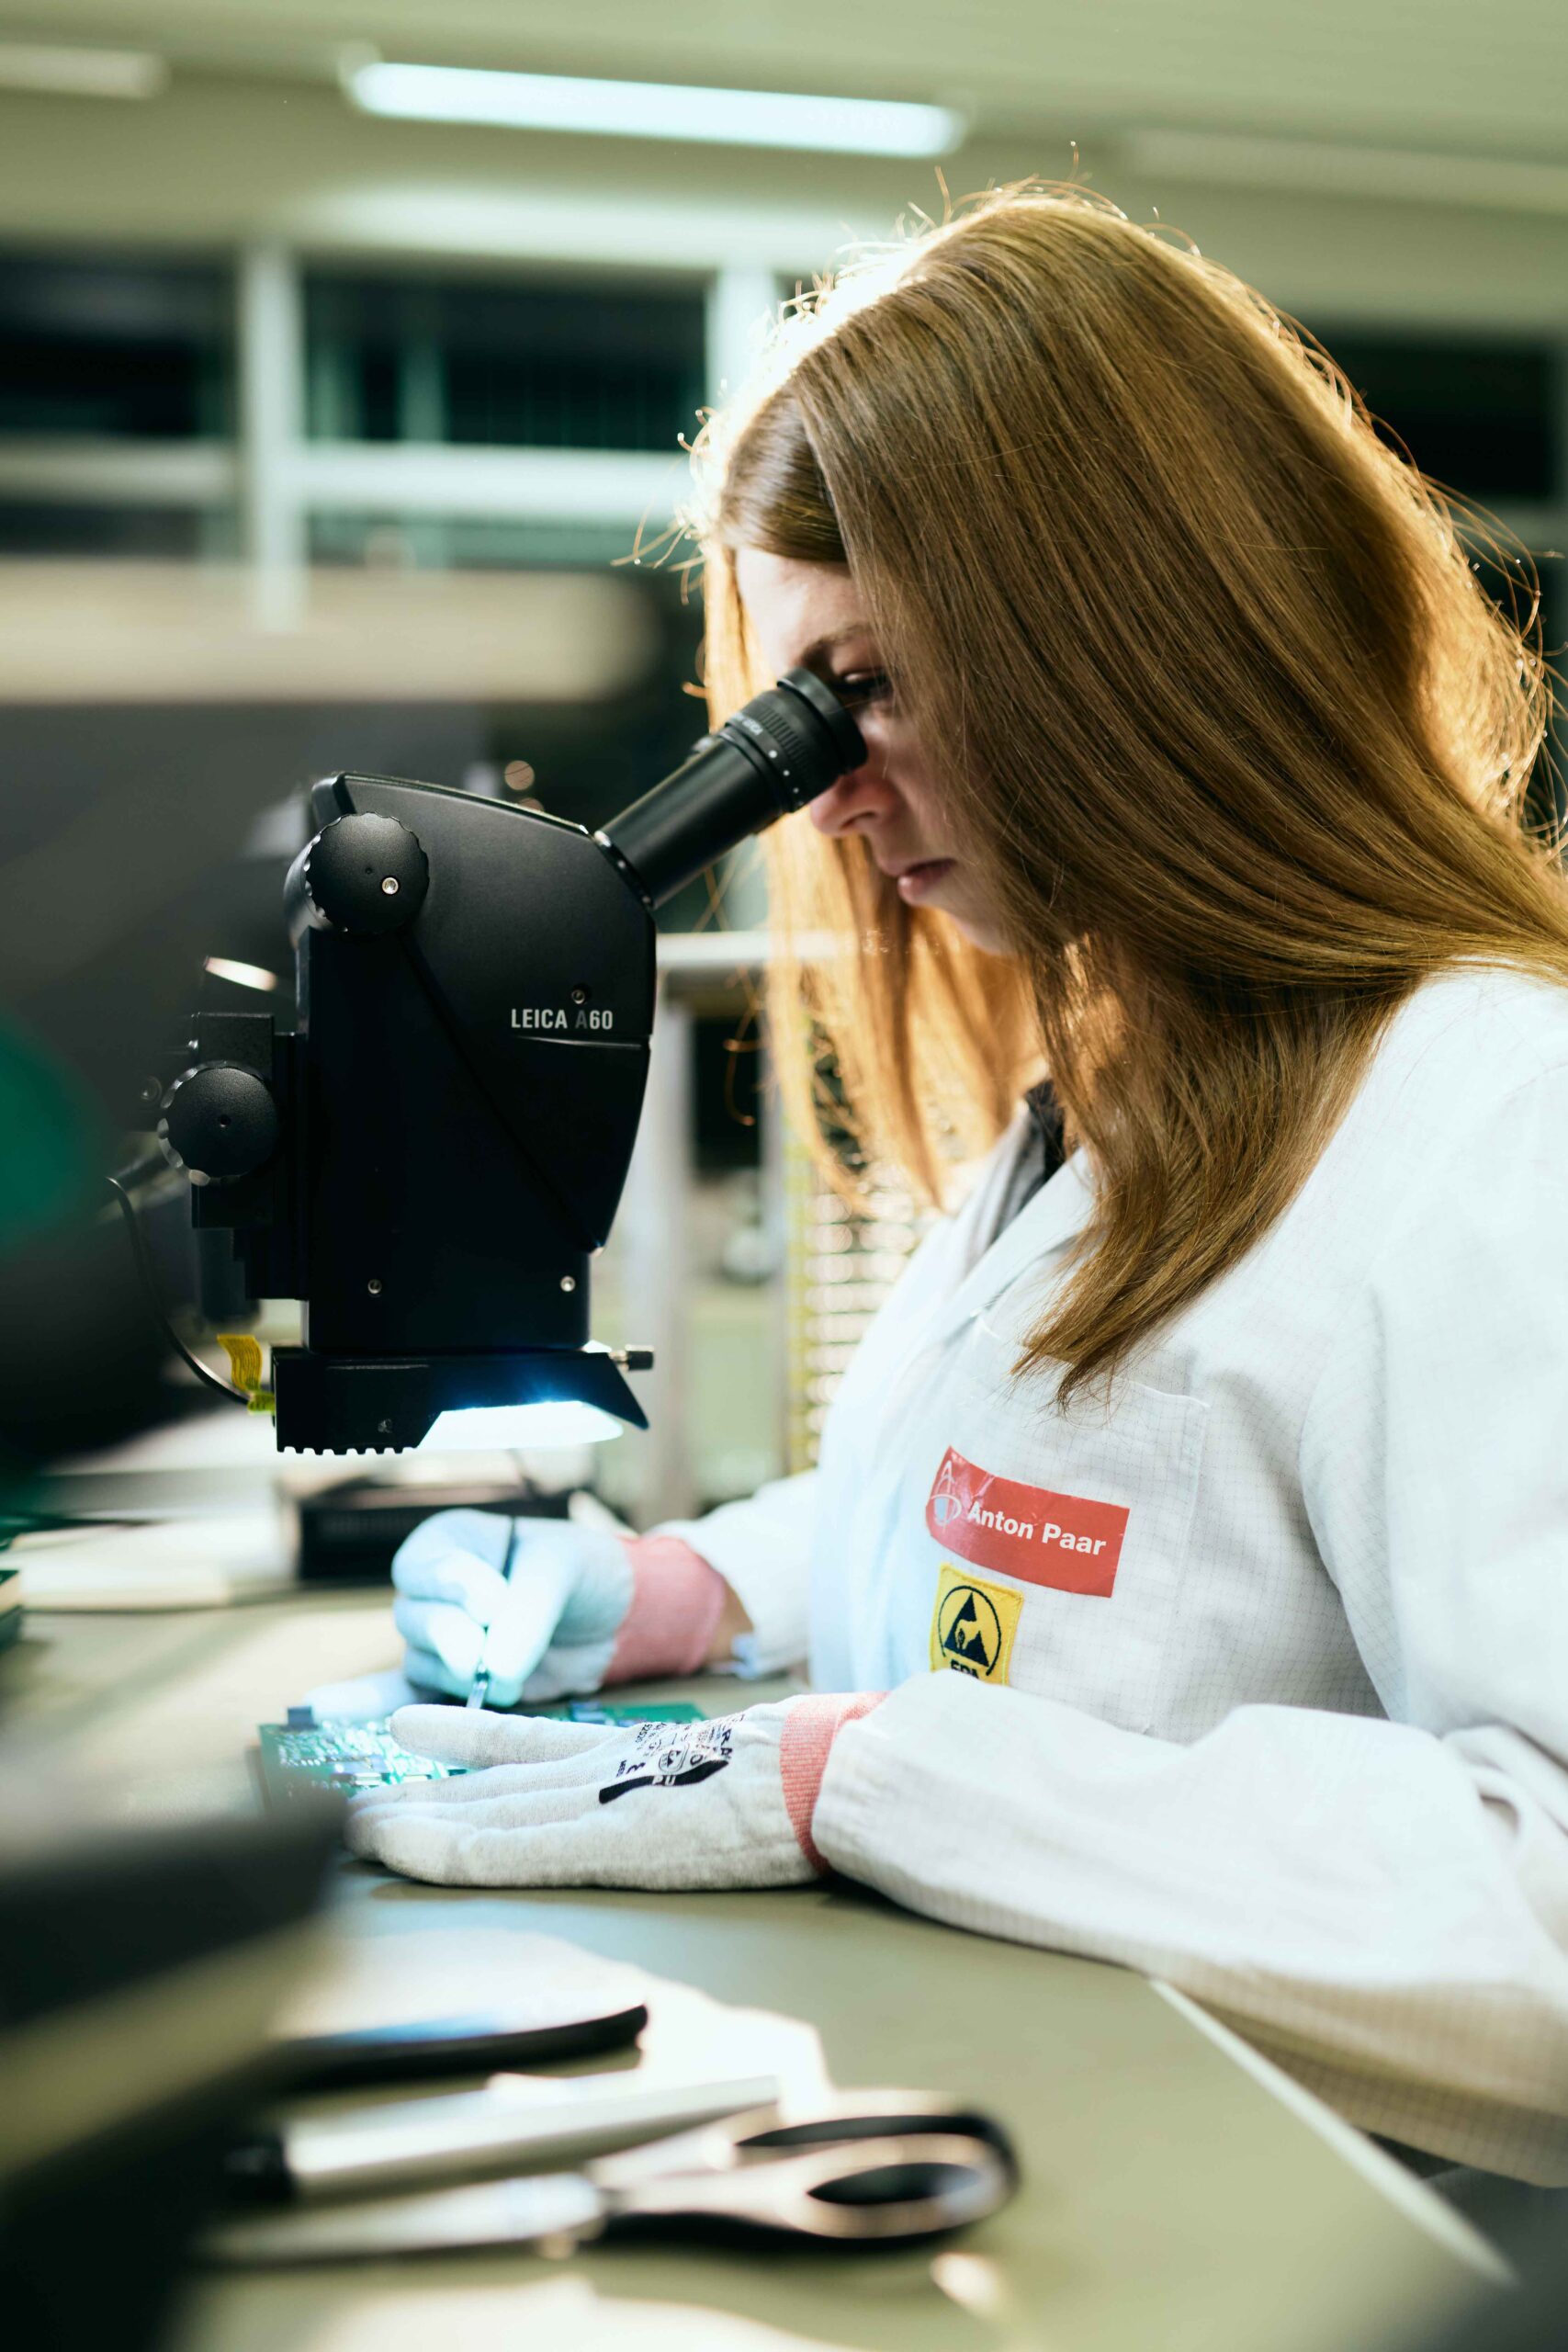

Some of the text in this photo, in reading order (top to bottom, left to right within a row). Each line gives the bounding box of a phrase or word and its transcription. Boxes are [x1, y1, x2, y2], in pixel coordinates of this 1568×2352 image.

[511, 1009, 614, 1030] LEICA A60
[967, 1501, 1107, 1556] Anton Paar
